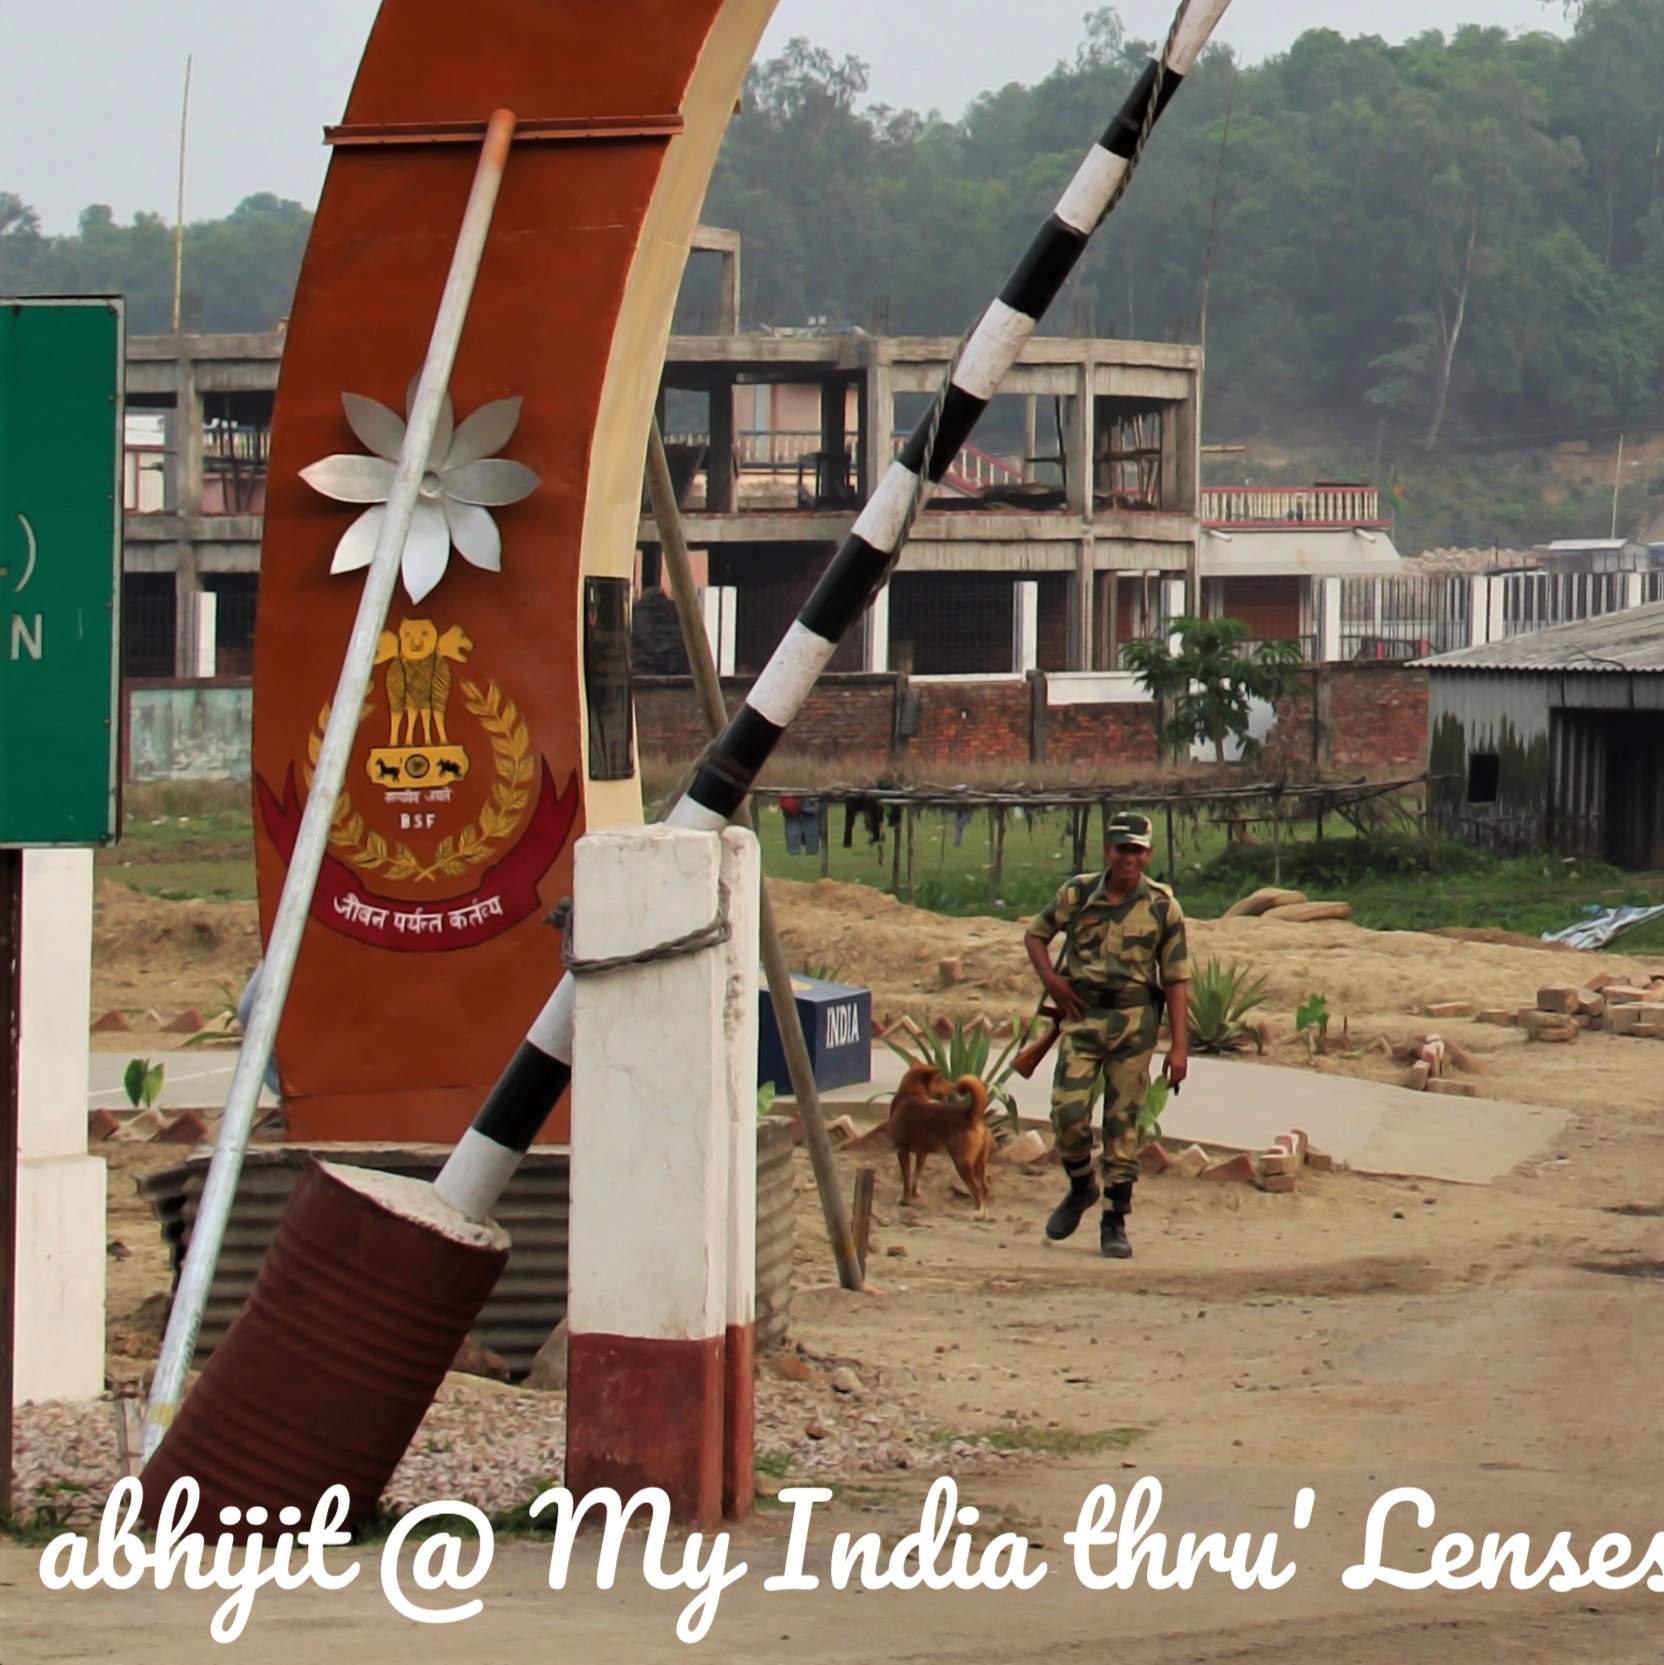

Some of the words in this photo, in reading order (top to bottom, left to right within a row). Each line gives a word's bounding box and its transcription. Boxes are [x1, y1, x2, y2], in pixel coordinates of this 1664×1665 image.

[400, 812, 436, 829] BSF
[333, 893, 389, 929] जीवन
[393, 907, 443, 934] पर्यन्त
[448, 895, 504, 929] कर्तव्य
[826, 1002, 859, 1049] INDIA
